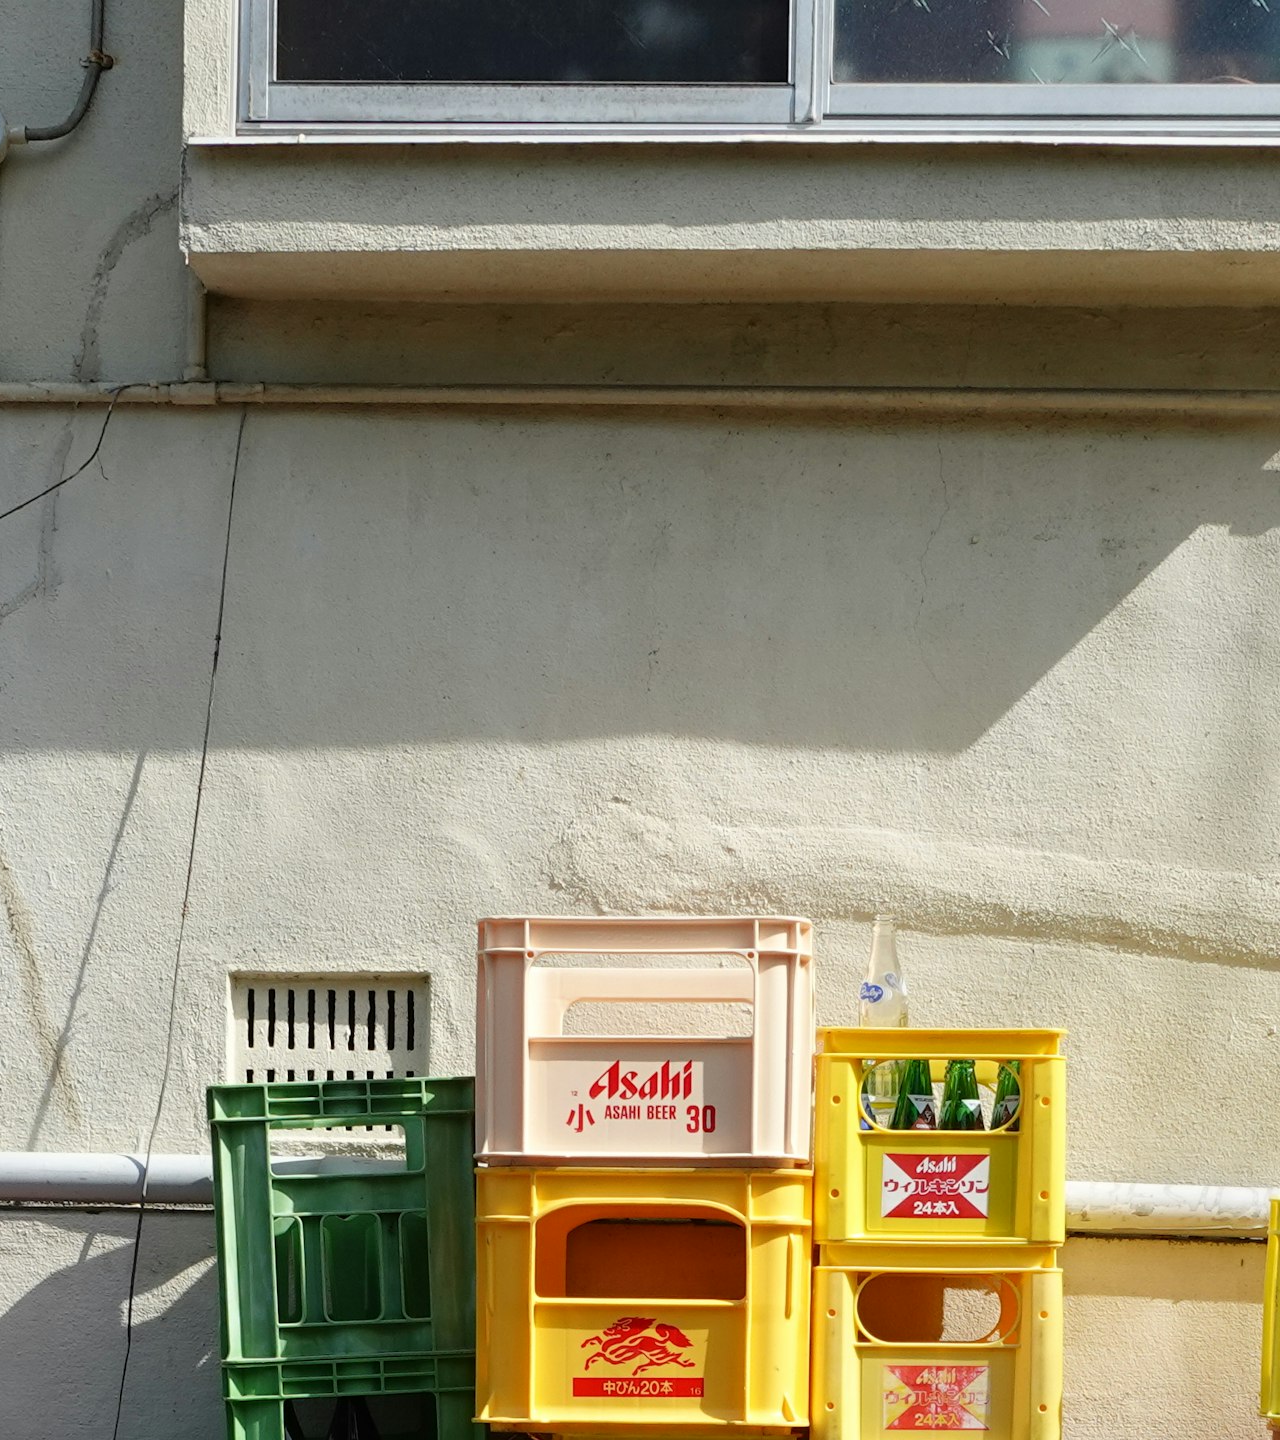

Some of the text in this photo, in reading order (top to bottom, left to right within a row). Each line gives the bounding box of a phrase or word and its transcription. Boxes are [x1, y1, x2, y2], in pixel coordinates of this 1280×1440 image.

[589, 1059, 692, 1100] Asahi
[566, 1103, 595, 1133] 小
[605, 1105, 677, 1120] ASAHI BEER
[686, 1105, 716, 1133] 30
[915, 1155, 957, 1174] Asahi
[883, 1179, 990, 1195] ウィルキンソン
[913, 1201, 960, 1215] 24本入
[915, 1367, 957, 1385] Asahi
[603, 1380, 702, 1395] 中びん20本 16
[914, 1412, 961, 1427] 24本入
